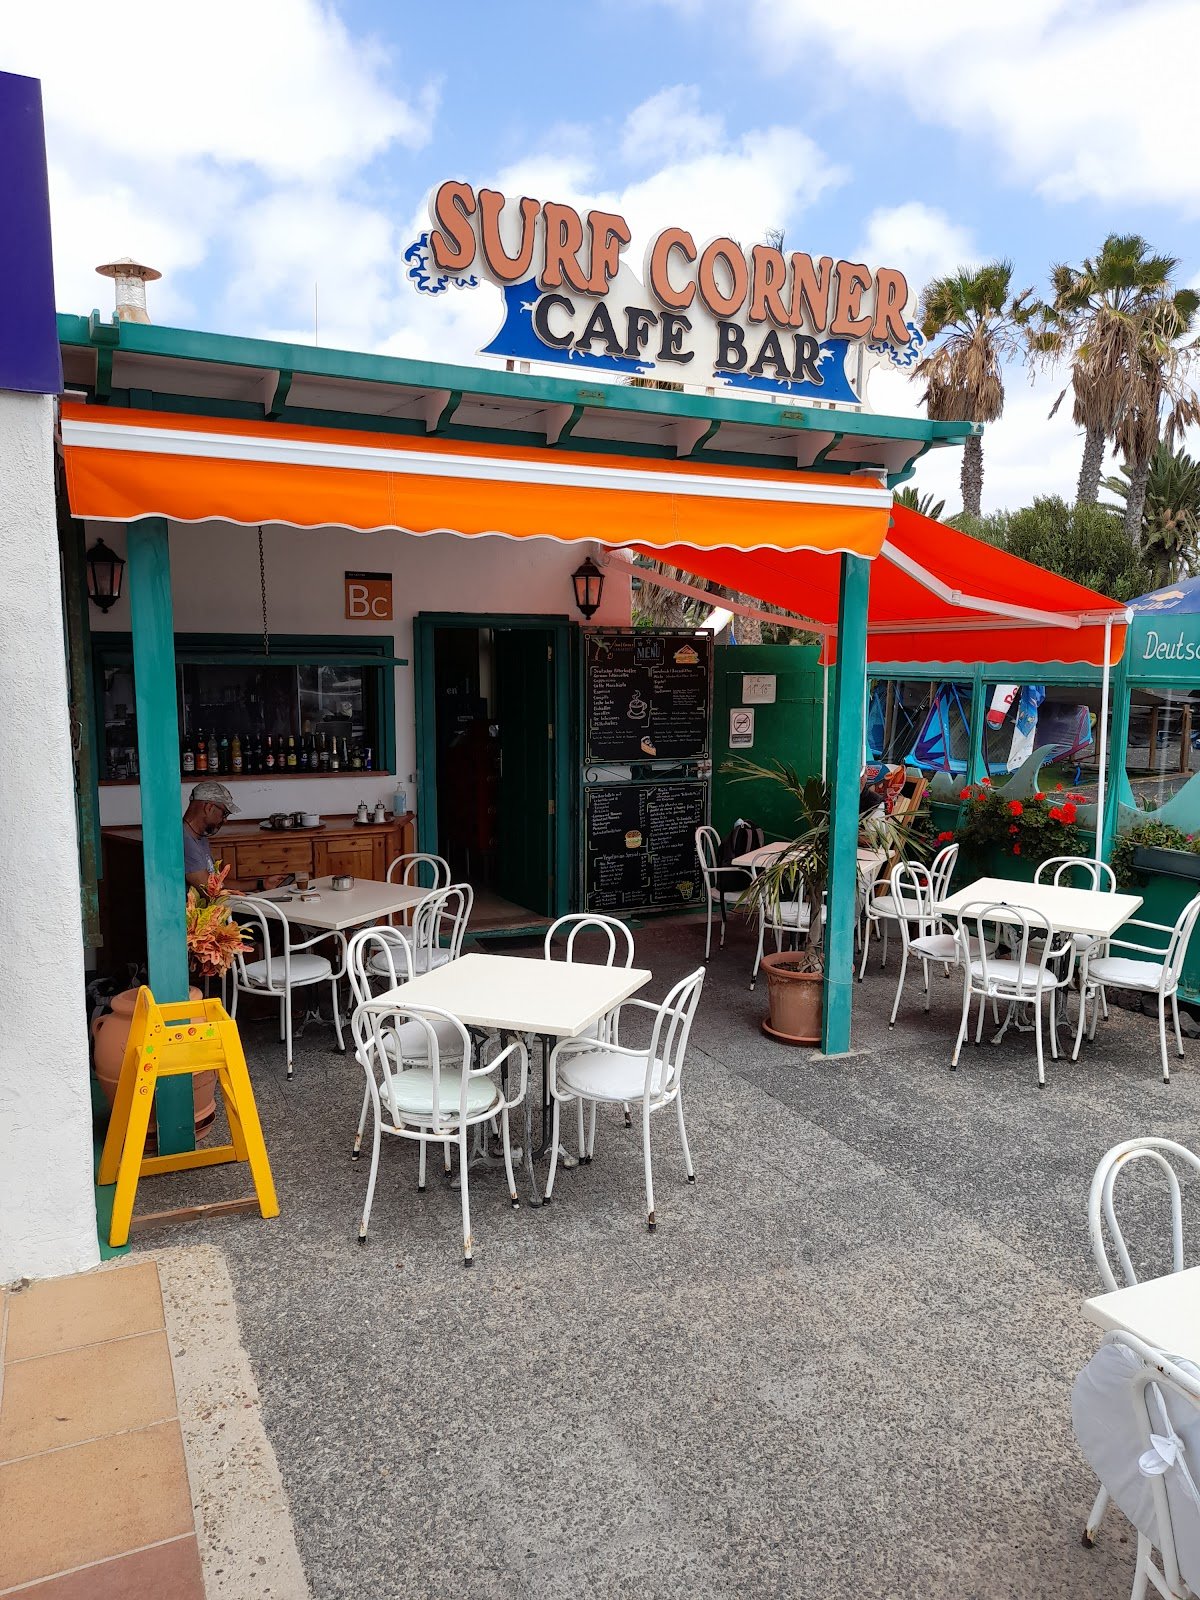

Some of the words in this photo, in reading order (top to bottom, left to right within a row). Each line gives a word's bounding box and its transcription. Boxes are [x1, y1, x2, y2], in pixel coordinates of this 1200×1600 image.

[430, 180, 632, 297] SURF
[647, 227, 911, 345] CORNER
[535, 293, 695, 364] CAFE
[716, 321, 825, 385] BAR
[637, 646, 661, 659] MENU
